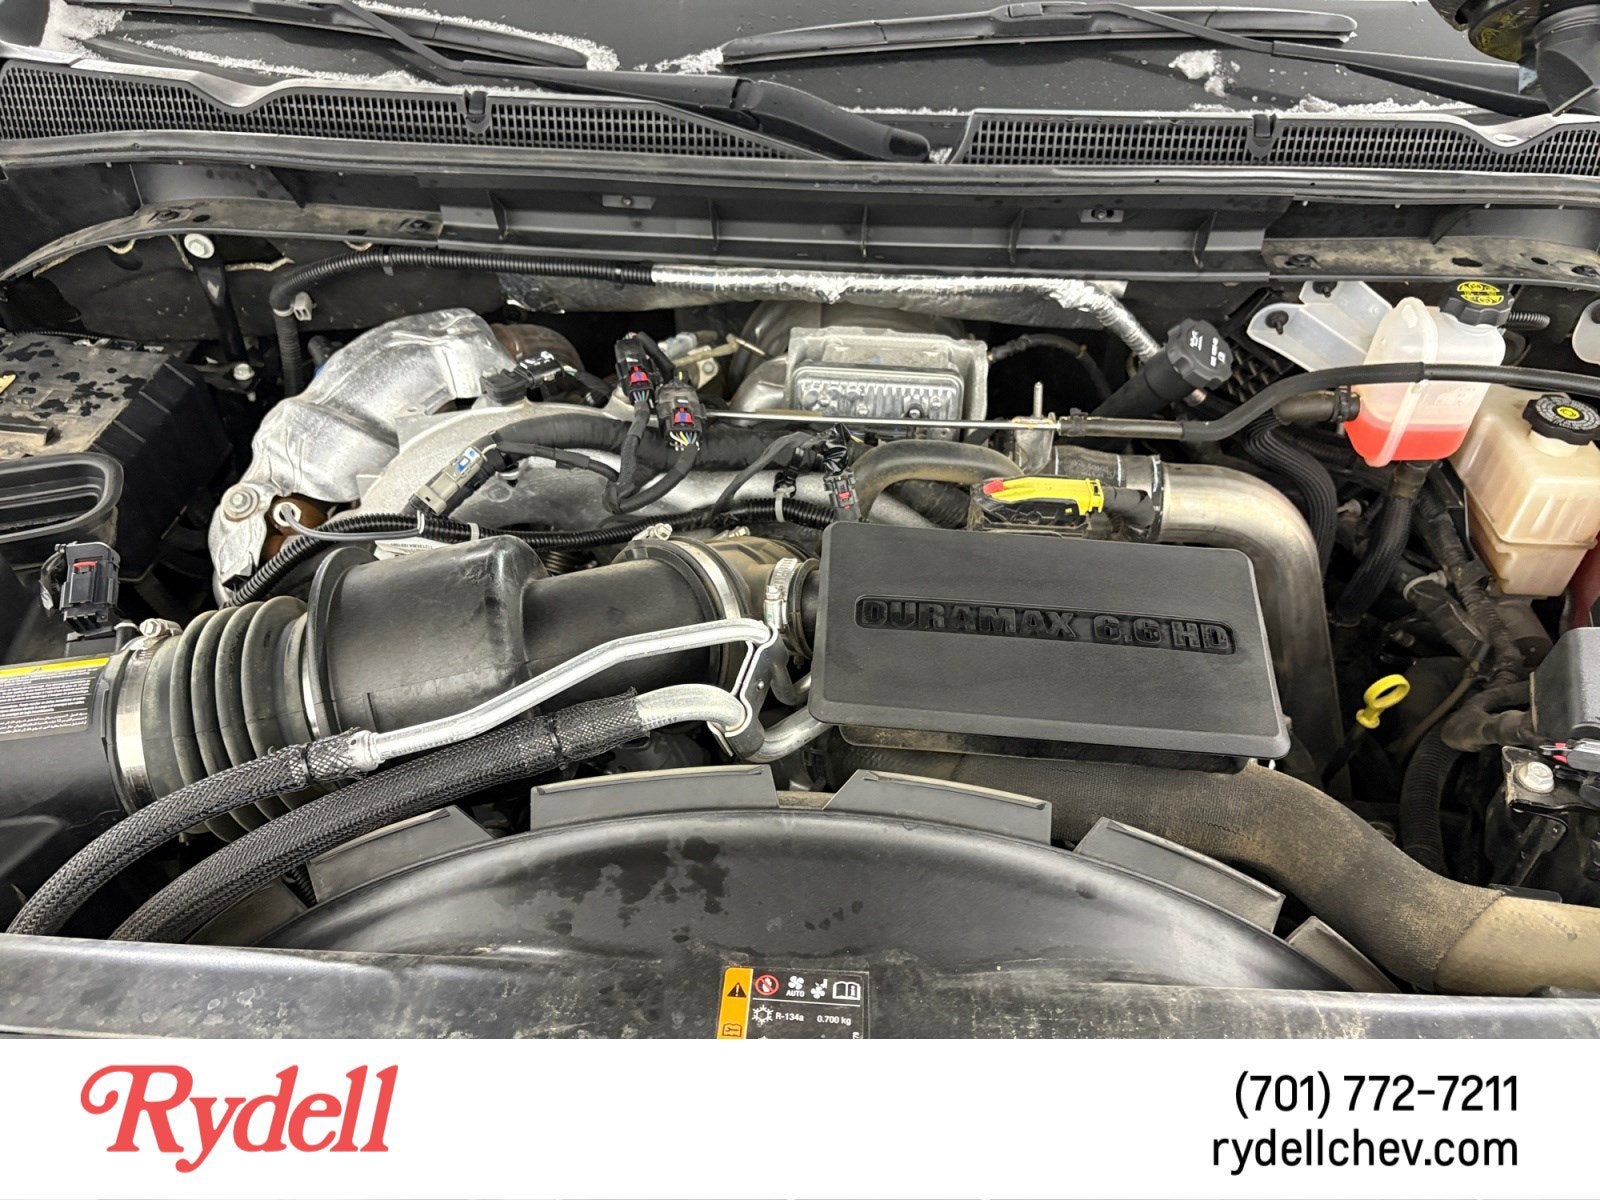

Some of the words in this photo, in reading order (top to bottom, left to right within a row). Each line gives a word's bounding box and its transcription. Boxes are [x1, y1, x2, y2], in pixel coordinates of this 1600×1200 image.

[861, 599, 1077, 639] DURAMAX
[1171, 620, 1230, 650] HD
[786, 989, 805, 998] AUTO
[775, 1012, 804, 1022] R-134a
[817, 1014, 839, 1024] 0.700
[841, 1014, 852, 1026] kg
